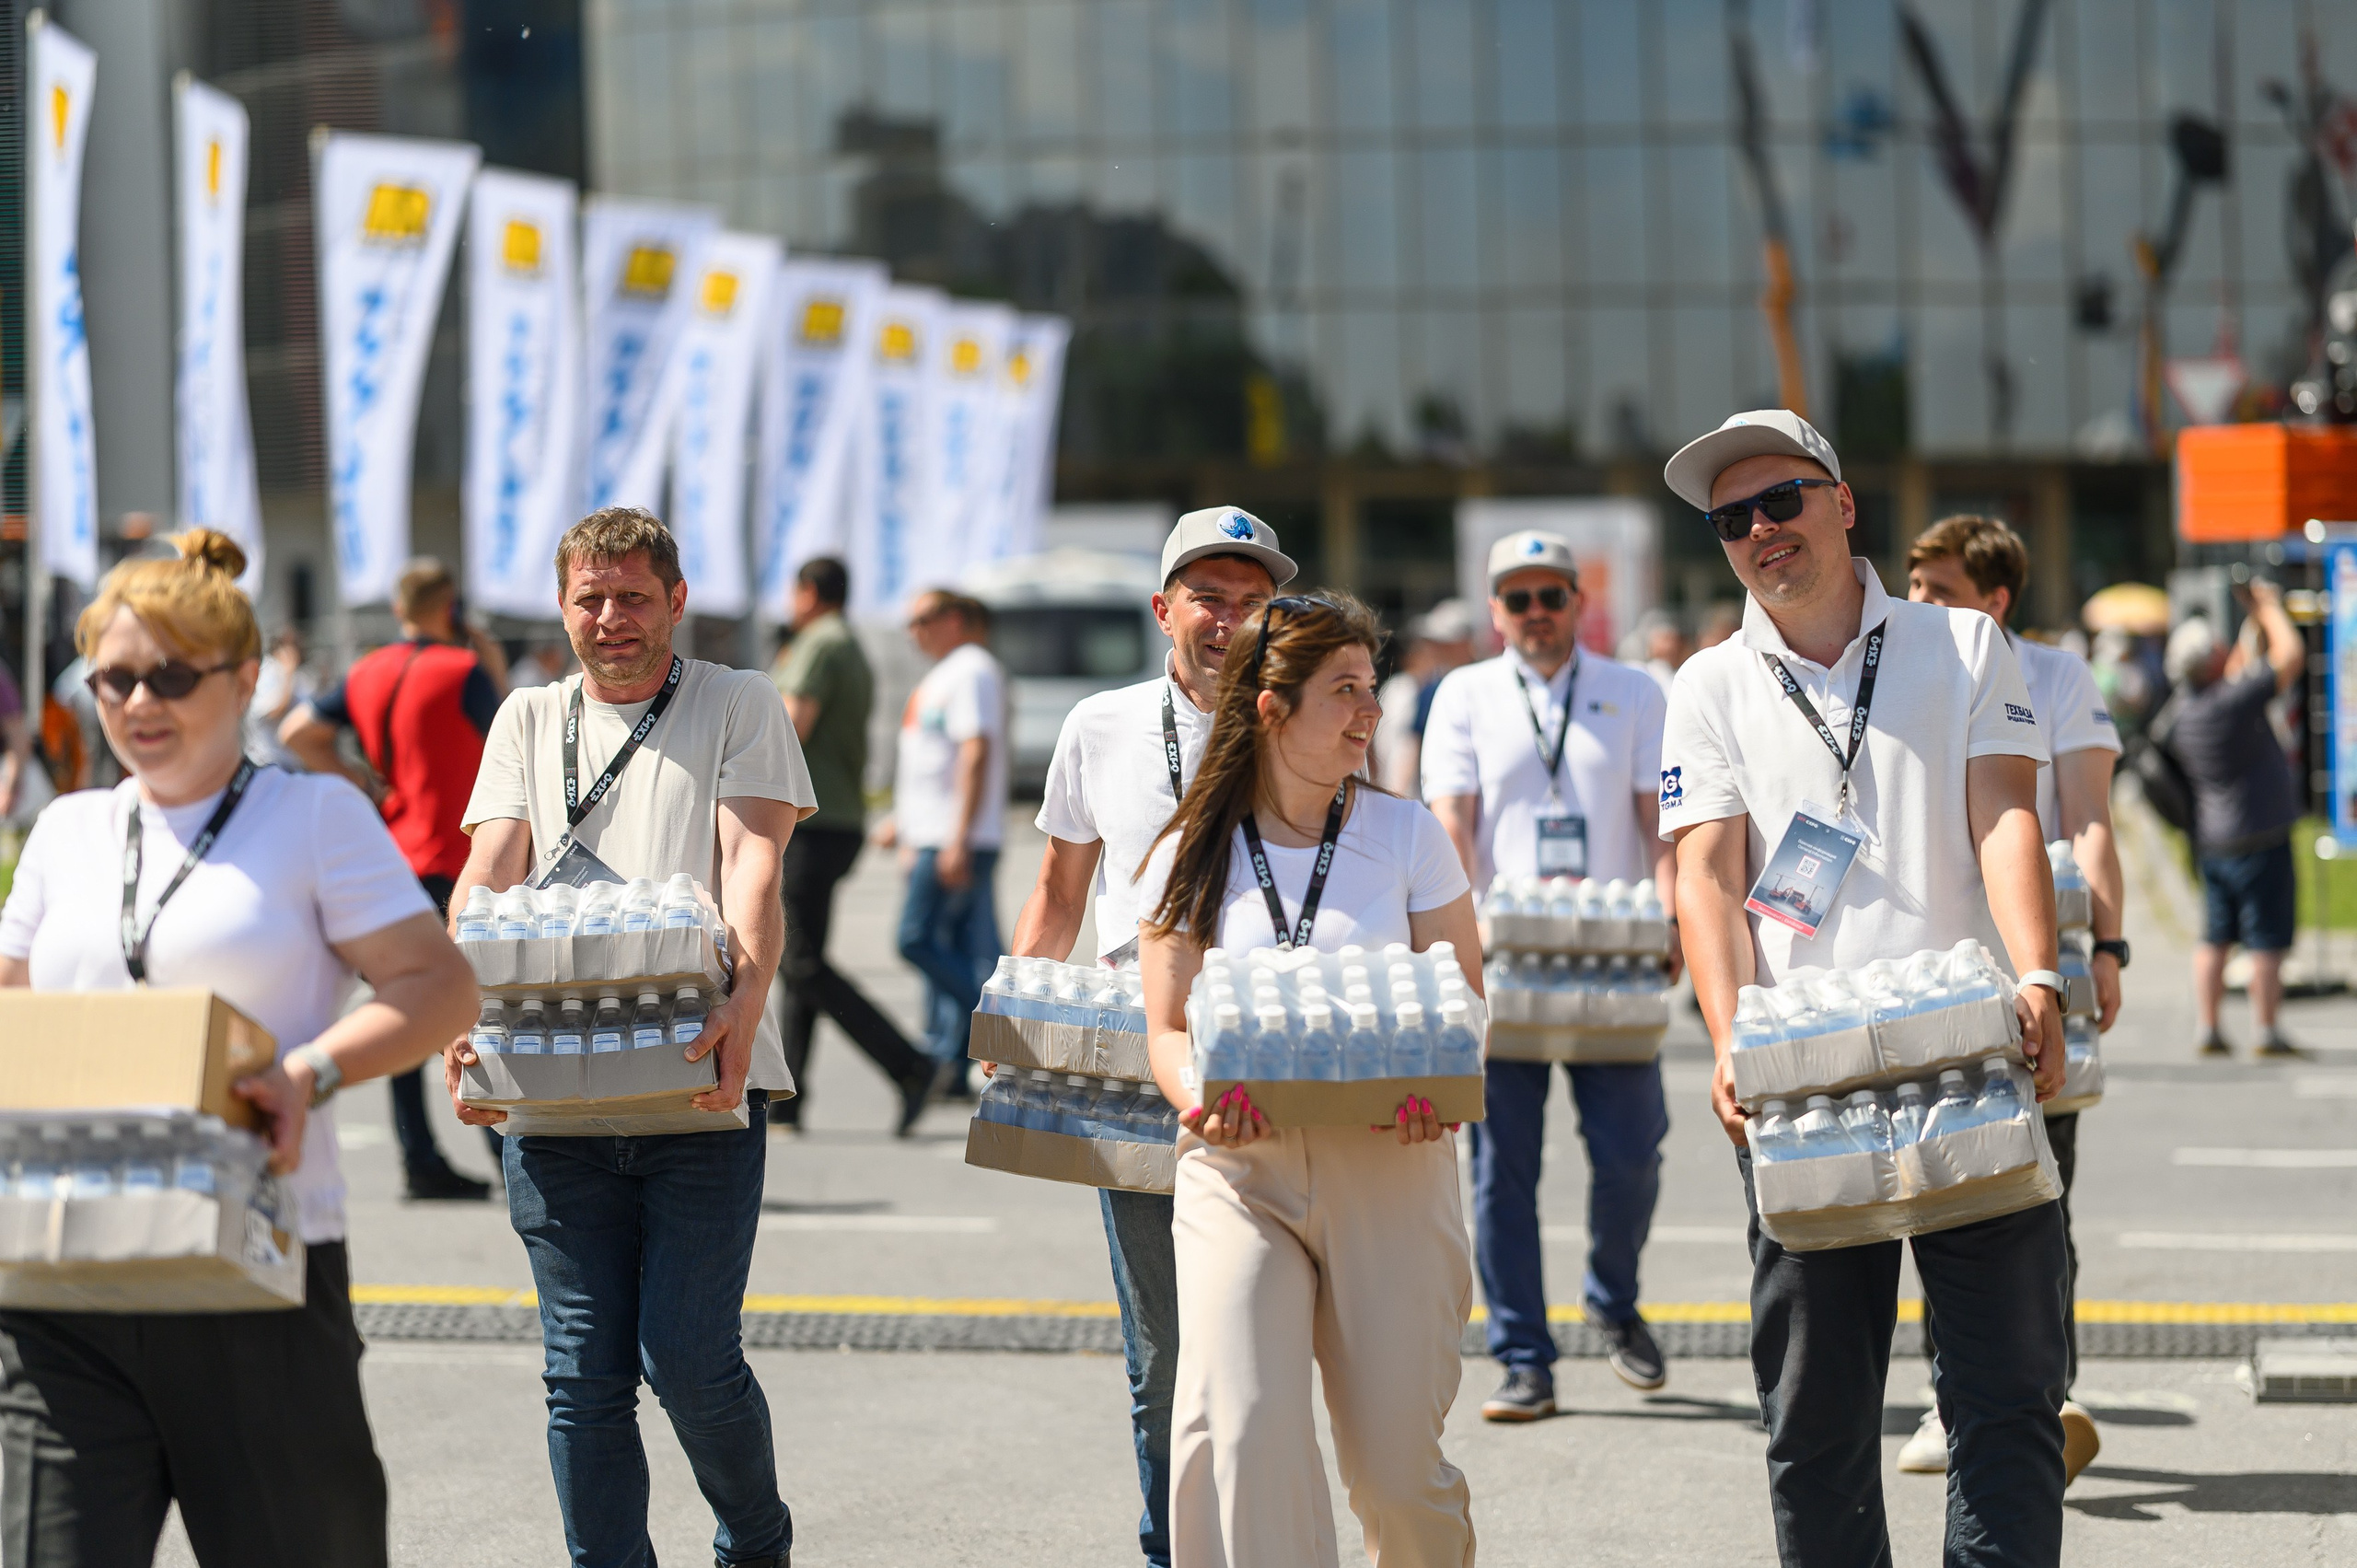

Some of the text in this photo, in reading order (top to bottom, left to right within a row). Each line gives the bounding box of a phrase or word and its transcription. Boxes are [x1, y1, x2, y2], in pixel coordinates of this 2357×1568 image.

[1866, 635, 1882, 667] EXPO
[668, 659, 682, 684] EXPO
[1773, 665, 1797, 693] EXPO
[1852, 706, 1868, 741] EXPO
[2004, 703, 2034, 719] ТЕХБАЗА
[565, 717, 575, 744] EXPO
[633, 713, 656, 741] EXPO
[1817, 725, 1840, 755] EXPO
[1167, 742, 1179, 772] EXPO
[566, 777, 576, 807] EXPO
[590, 772, 615, 802] EXPO
[1253, 853, 1272, 889] EXPO
[1316, 842, 1334, 876] EXPO
[1294, 918, 1312, 948] XPO
